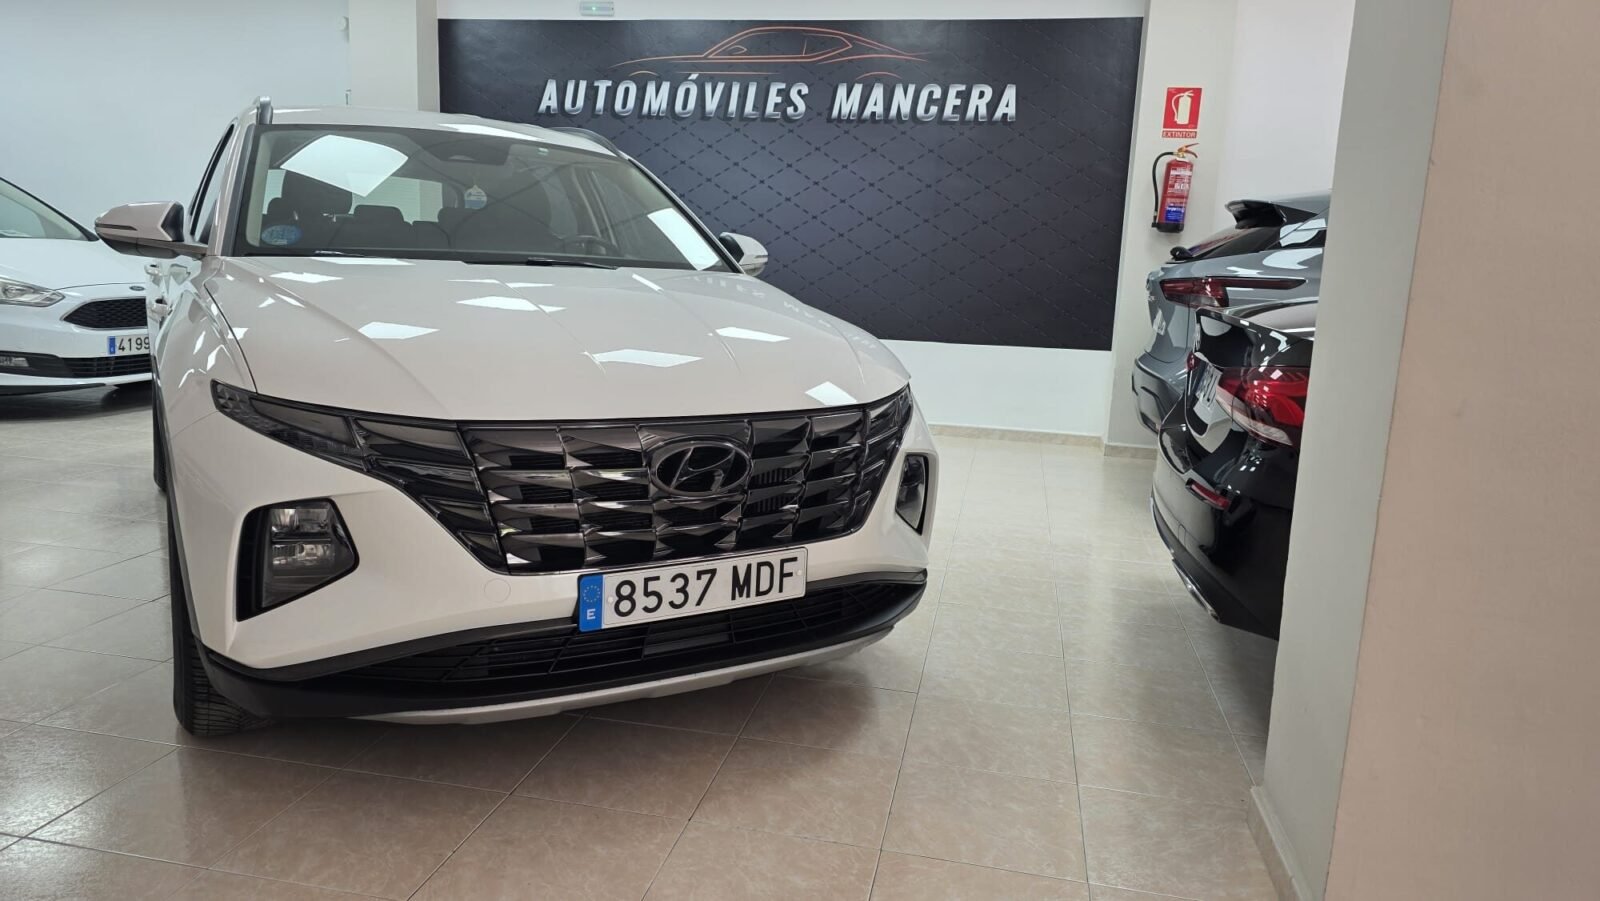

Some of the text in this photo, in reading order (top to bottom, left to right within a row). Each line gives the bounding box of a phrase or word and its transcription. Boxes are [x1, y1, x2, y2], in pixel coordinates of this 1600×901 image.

[537, 73, 1018, 122] AUTOMÓVILES MANCERA
[118, 336, 150, 351] 4199
[613, 556, 798, 618] 8537 MDF
[586, 608, 596, 620] E
